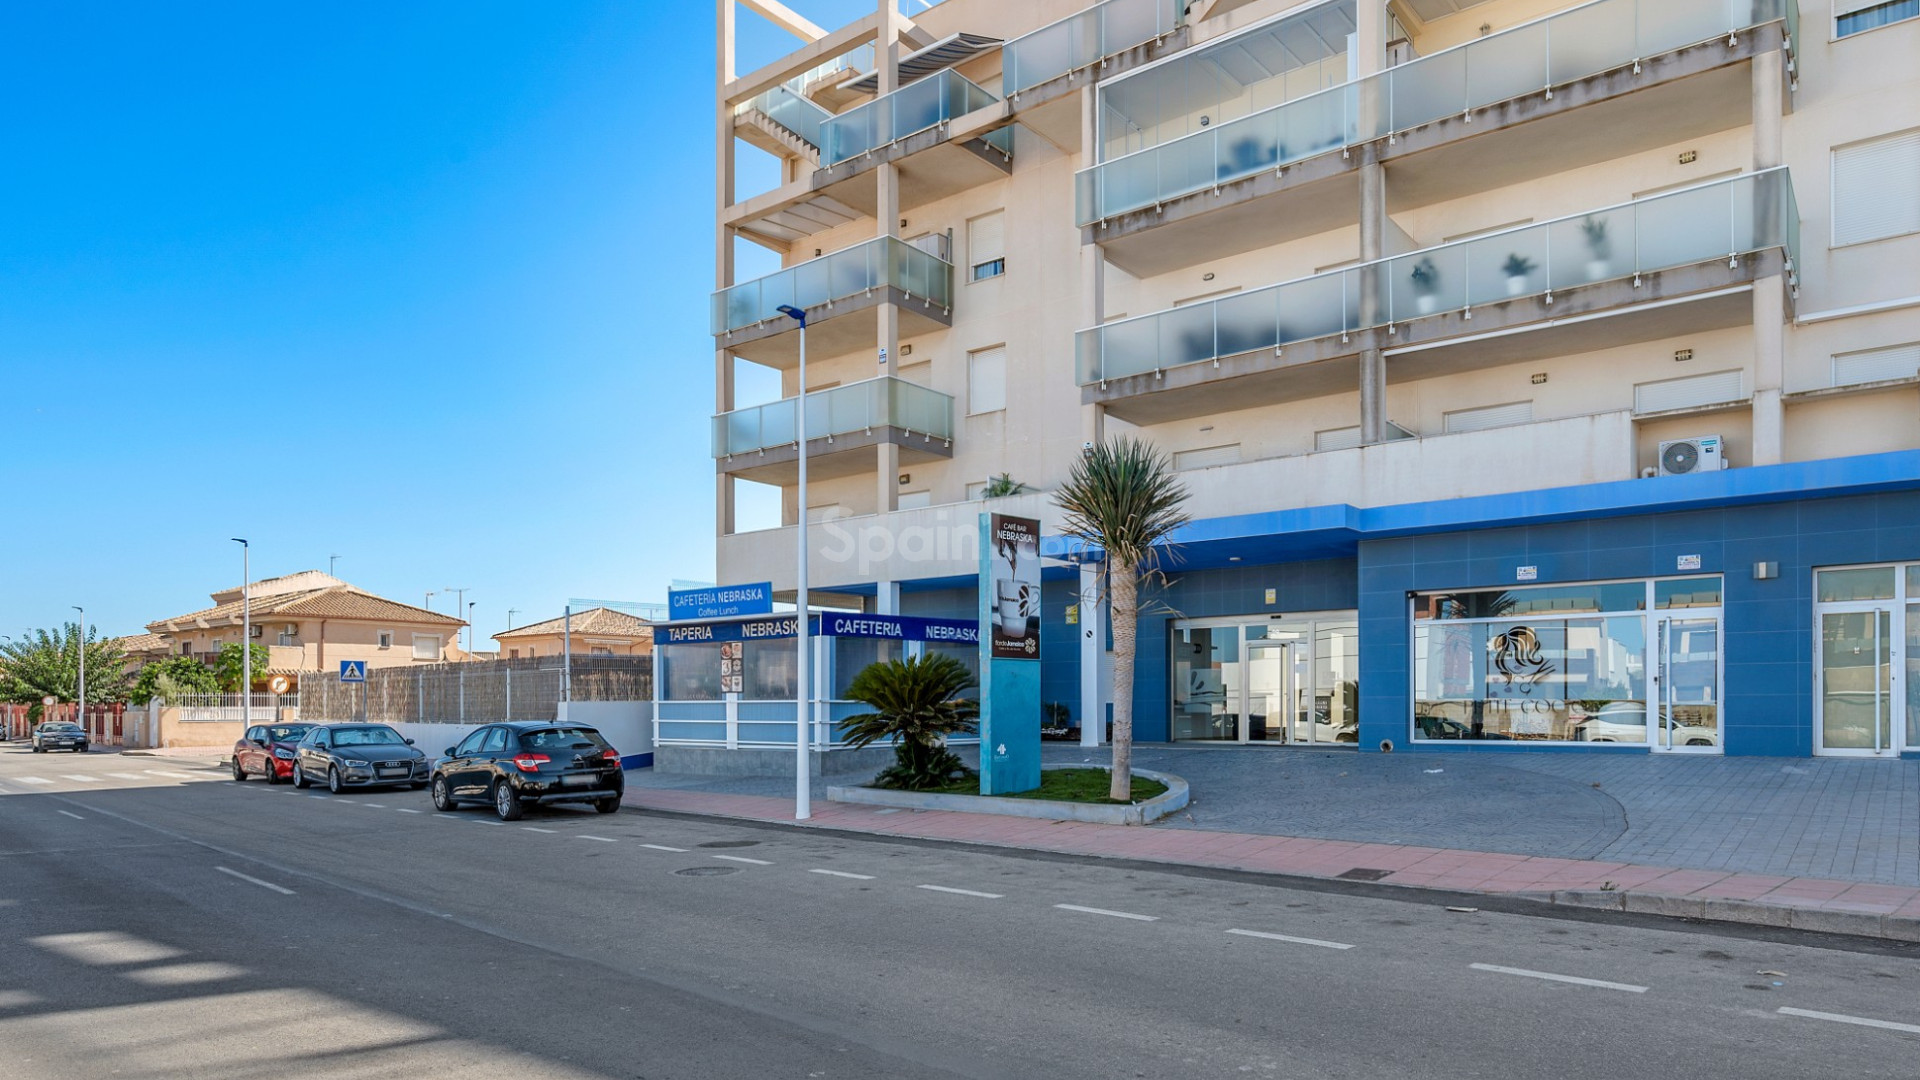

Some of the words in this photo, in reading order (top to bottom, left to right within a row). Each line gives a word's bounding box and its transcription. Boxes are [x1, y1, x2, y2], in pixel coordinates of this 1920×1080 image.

[996, 529, 1033, 543] NEBRASKA
[717, 587, 763, 604] NEBRASKA
[698, 607, 718, 617] Coffee
[719, 606, 739, 616] Lunch
[668, 625, 713, 642] TAPERIA
[742, 620, 799, 638] NEBRASK
[834, 618, 904, 637] CAFETERIA
